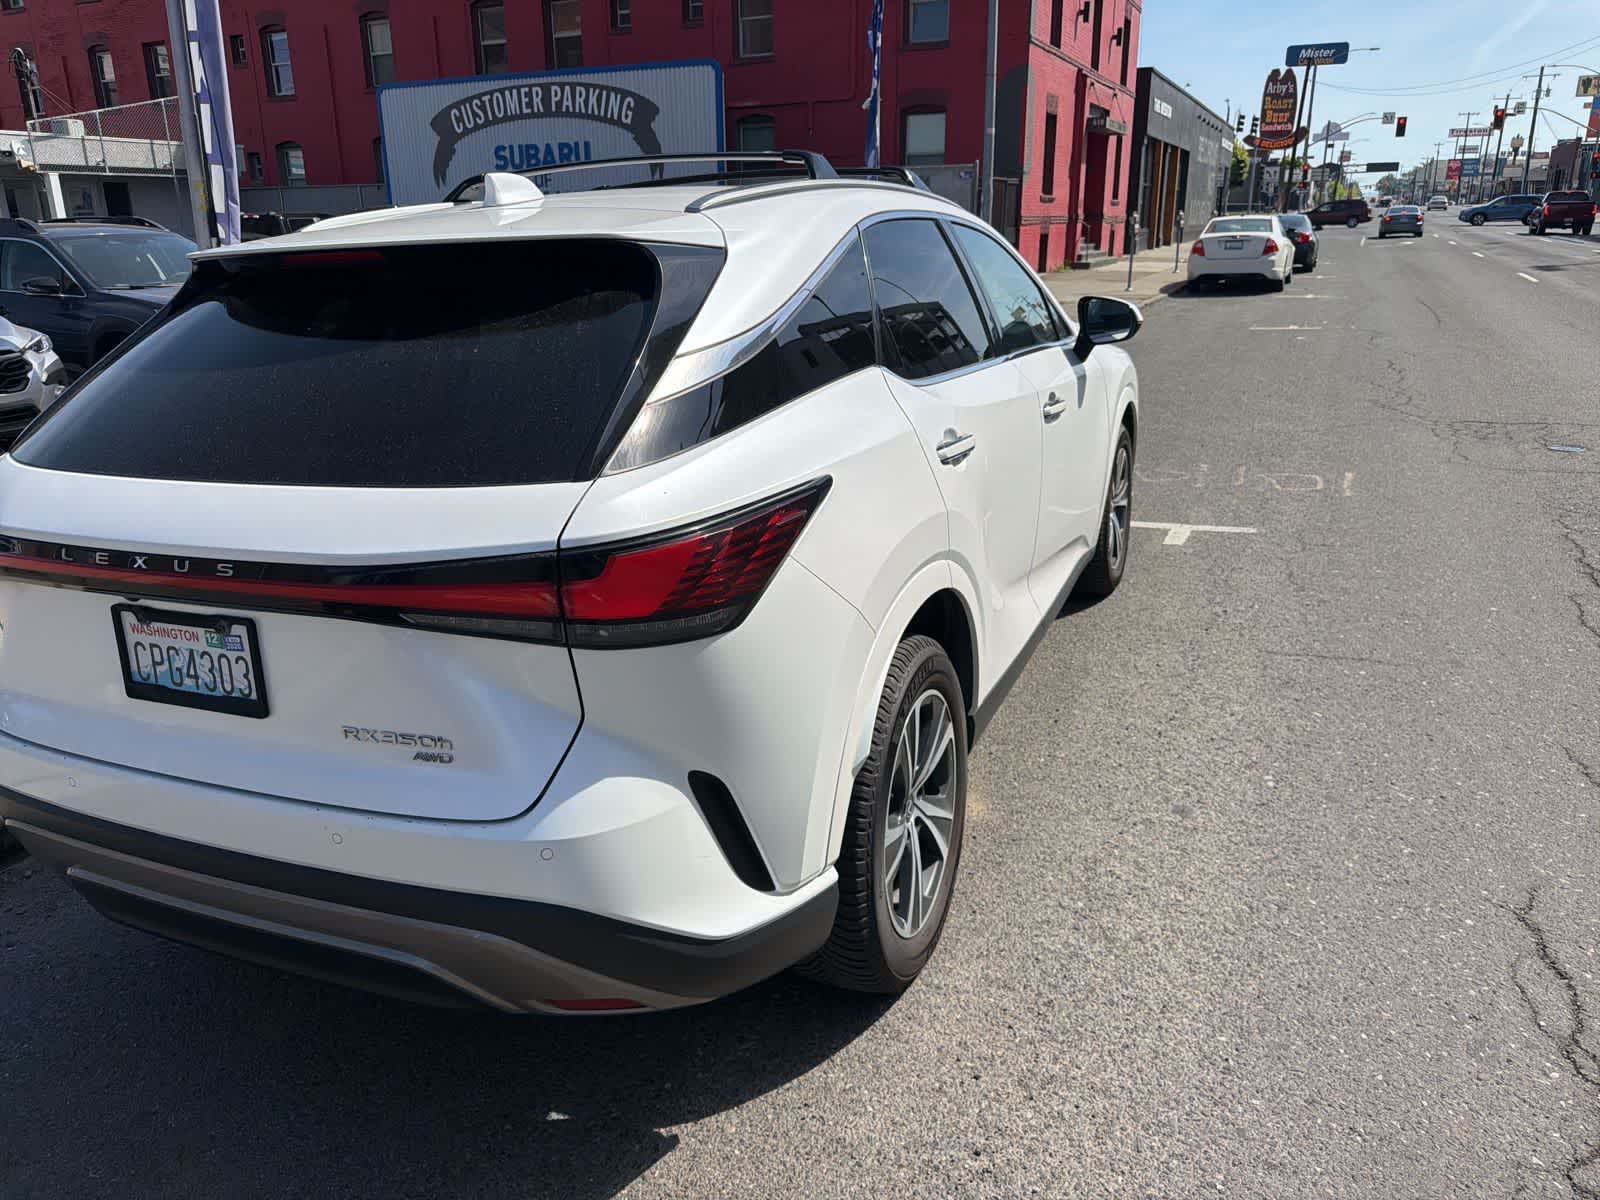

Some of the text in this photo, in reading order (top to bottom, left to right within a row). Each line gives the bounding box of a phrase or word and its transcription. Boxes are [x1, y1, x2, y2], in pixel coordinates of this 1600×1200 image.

[1299, 48, 1336, 59] Mister
[1267, 82, 1294, 96] Arby's
[450, 85, 635, 134] CUSTOMER PARKING
[1264, 96, 1294, 109] ROAST
[1266, 110, 1290, 123] BEEF
[494, 140, 592, 171] SUBARU
[61, 546, 234, 577] LEXUS
[129, 622, 200, 643] WASHINGTON
[134, 641, 252, 698] CPG4303
[341, 725, 453, 750] RX350h
[412, 751, 454, 764] AWD
